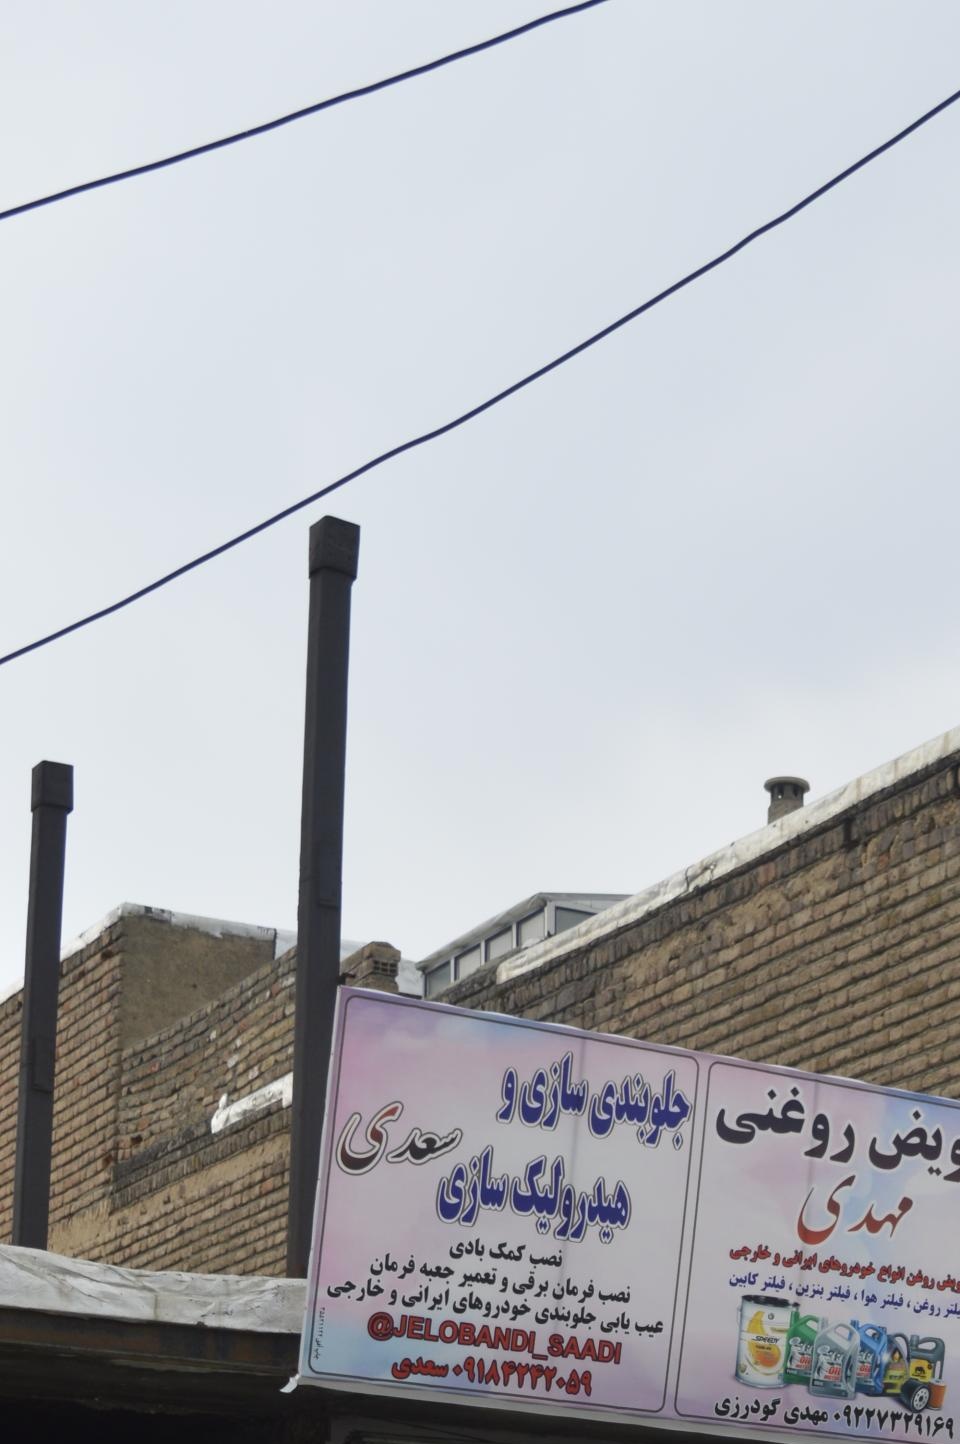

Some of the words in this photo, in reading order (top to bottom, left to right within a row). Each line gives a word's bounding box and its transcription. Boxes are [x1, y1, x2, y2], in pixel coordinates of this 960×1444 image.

[497, 1065, 517, 1123] و
[519, 1051, 589, 1131] سازی
[588, 1066, 693, 1150] جلوبندی
[715, 1086, 855, 1164] روغنی
[336, 1101, 463, 1176] سعدی
[436, 1145, 510, 1227] سازی
[511, 1153, 631, 1244] هیدرولیک
[797, 1174, 914, 1245] مهدی
[449, 1239, 485, 1260] بادی
[489, 1243, 526, 1262] کمک
[529, 1249, 563, 1268] نصب
[730, 1244, 771, 1263] خارجی
[773, 1254, 781, 1266] و
[782, 1250, 817, 1271] ایرانی
[370, 1254, 416, 1279] فرمان
[420, 1263, 454, 1284] جعبه
[818, 1255, 876, 1278] خودروهای
[877, 1264, 905, 1283] انواع
[327, 1278, 385, 1301] خارجی
[458, 1268, 497, 1289] تعمیر
[501, 1278, 509, 1293] و
[512, 1272, 549, 1298] برقی
[728, 1271, 759, 1290] کابین
[761, 1275, 786, 1293] فیلتر
[906, 1270, 935, 1291] روغن
[390, 1290, 398, 1306] و
[401, 1283, 450, 1311] ایرانی
[553, 1278, 594, 1302] فرمان
[598, 1286, 631, 1304] نصب
[795, 1281, 824, 1299] بنزین
[826, 1284, 851, 1302] فیلتر
[861, 1287, 879, 1306] هوا
[881, 1292, 904, 1310] فیلتر
[452, 1292, 531, 1321] خودروهای
[534, 1304, 597, 1331] جلوبندی
[913, 1298, 941, 1317] روغن
[600, 1312, 630, 1334] یابی
[634, 1319, 664, 1338] عیب
[367, 1311, 623, 1364] @JELOBANDI_SAADI
[391, 1356, 449, 1380] سعدی
[452, 1356, 592, 1397] ۰۹۱۸۴۲۴۲۰۵۹
[714, 1396, 781, 1421] گودرزی
[784, 1403, 828, 1425] مهدی
[834, 1404, 954, 1440] ۰۹۲۲۷۳۲۹۱۶۹
